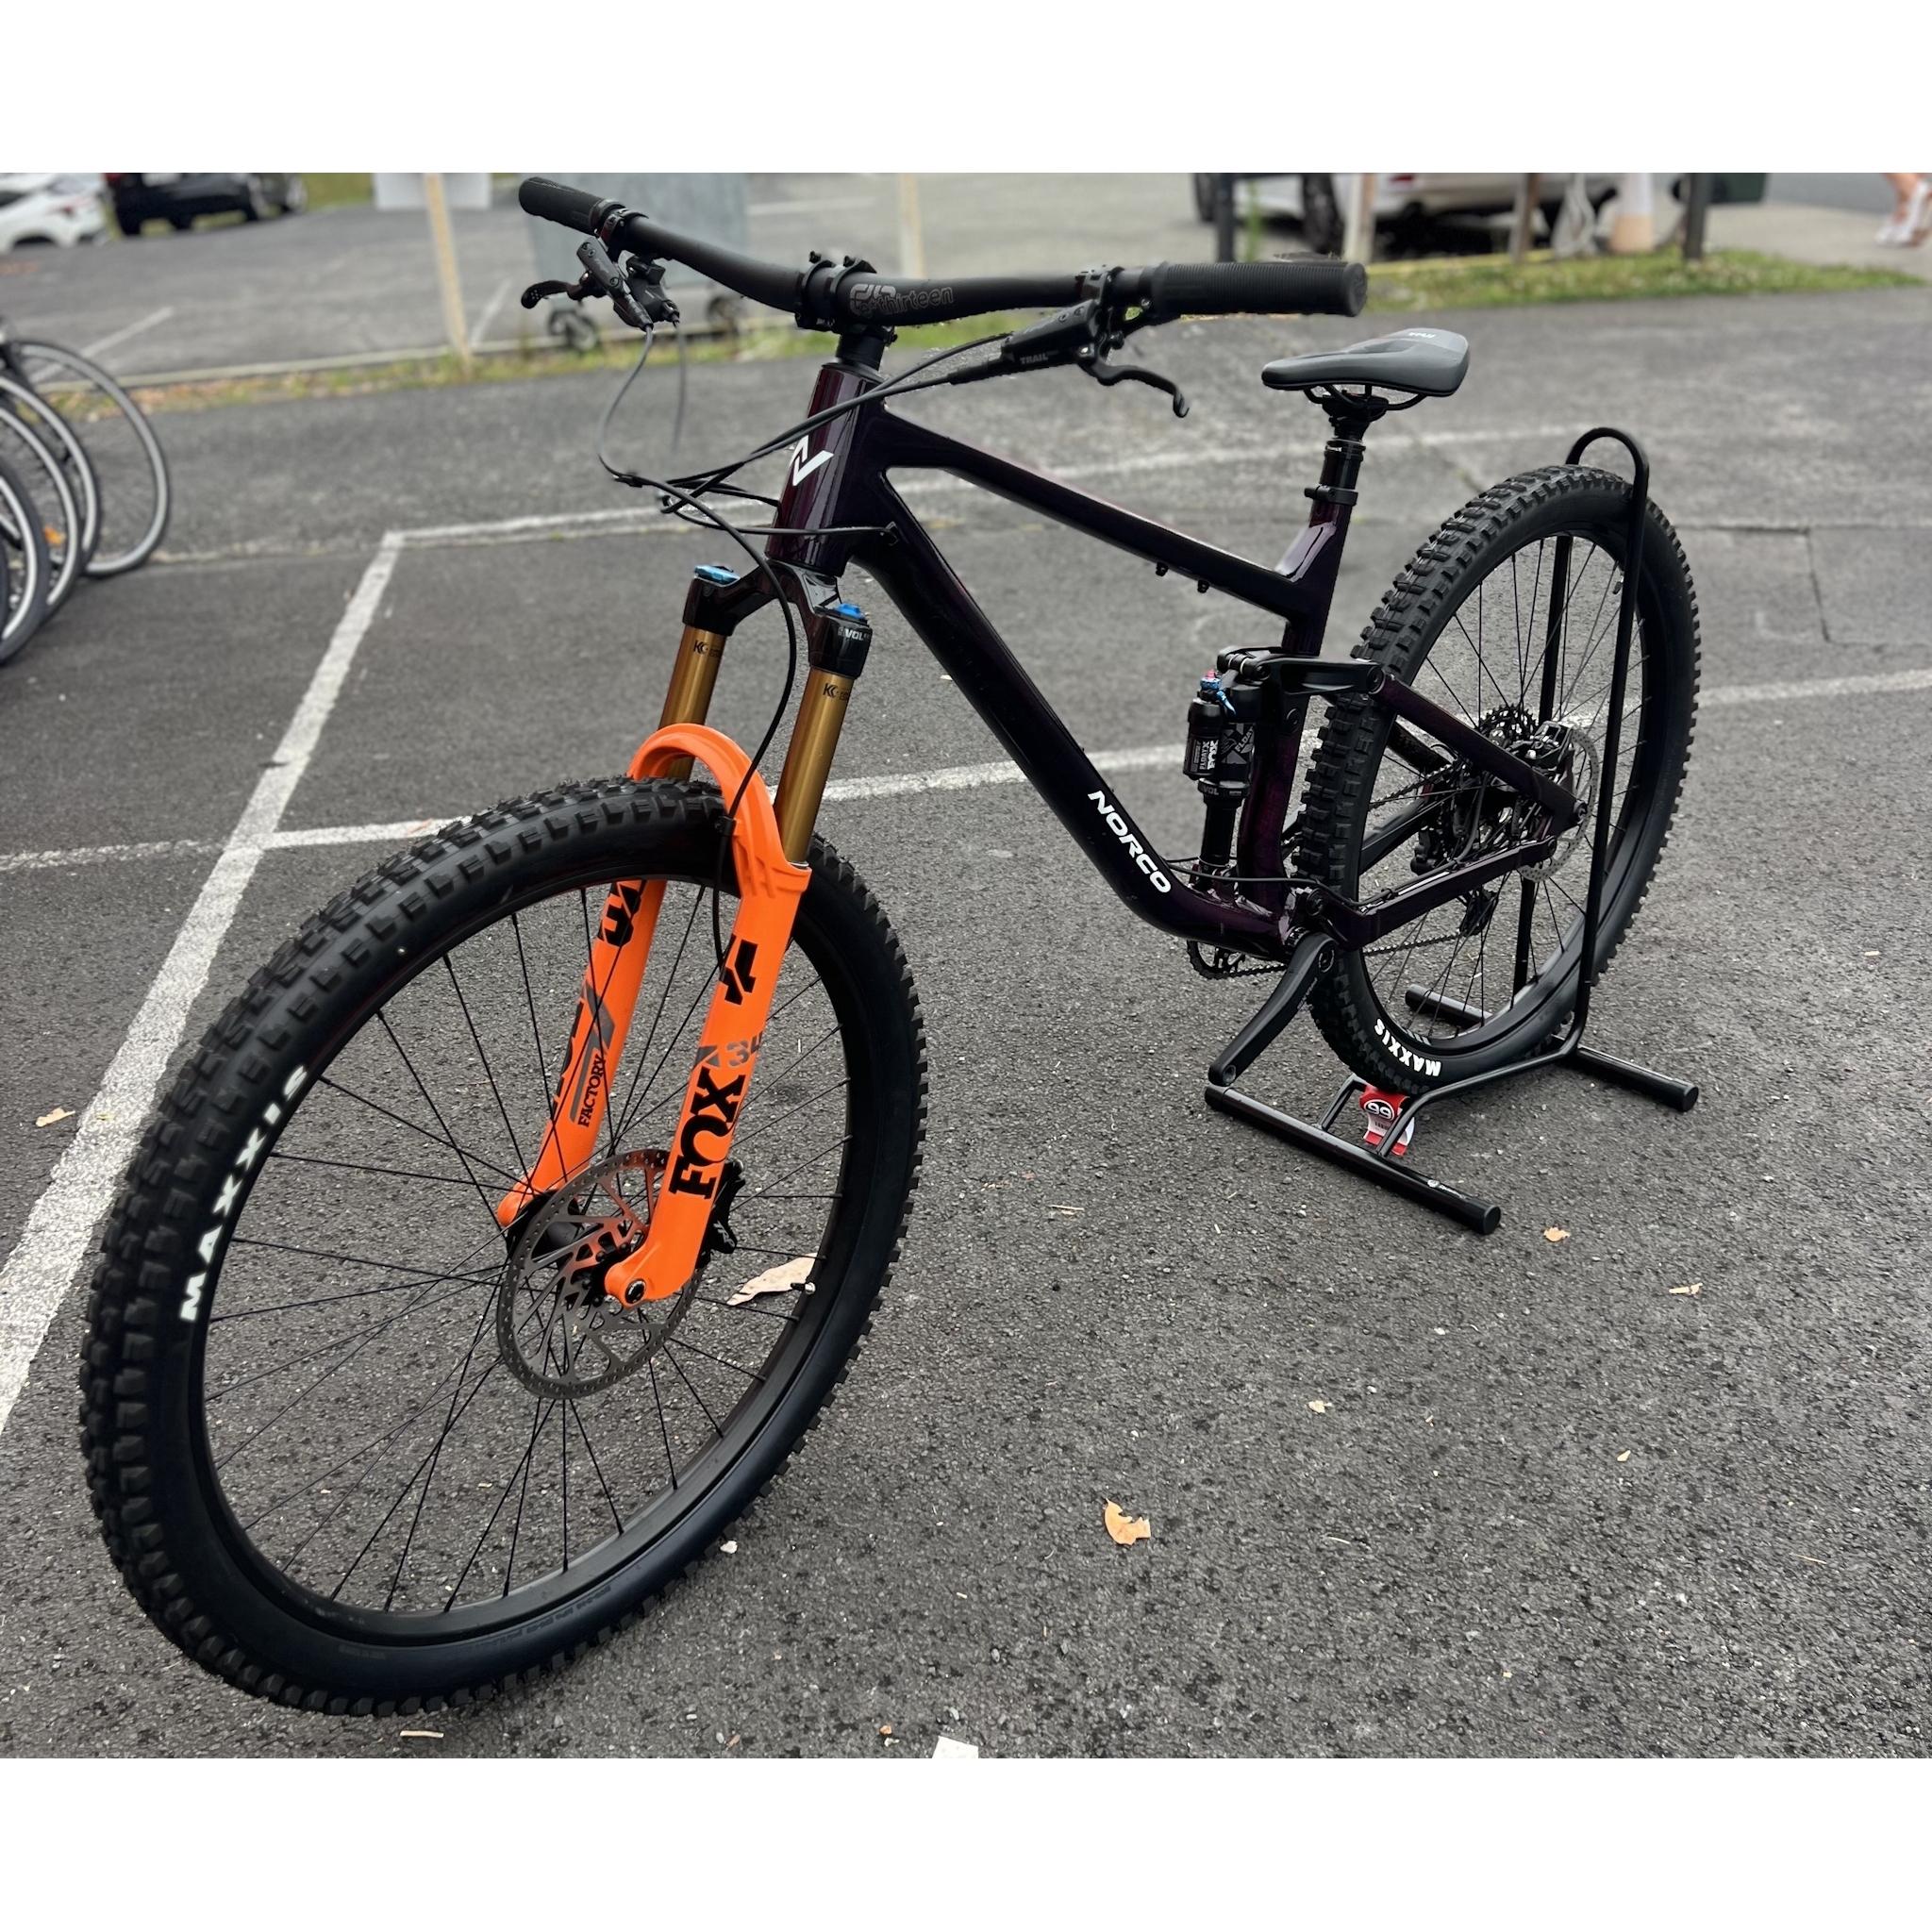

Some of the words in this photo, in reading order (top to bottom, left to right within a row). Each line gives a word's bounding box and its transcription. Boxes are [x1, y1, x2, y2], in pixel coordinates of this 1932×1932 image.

[1020, 352, 1048, 364] TRAIL
[1088, 791, 1171, 893] NORCO
[1374, 1019, 1441, 1076] MAXXIS
[577, 1053, 606, 1128] FACTORY
[1368, 1102, 1391, 1119] 99
[668, 1065, 745, 1200] FOX
[180, 1065, 308, 1322] MAXXIS
